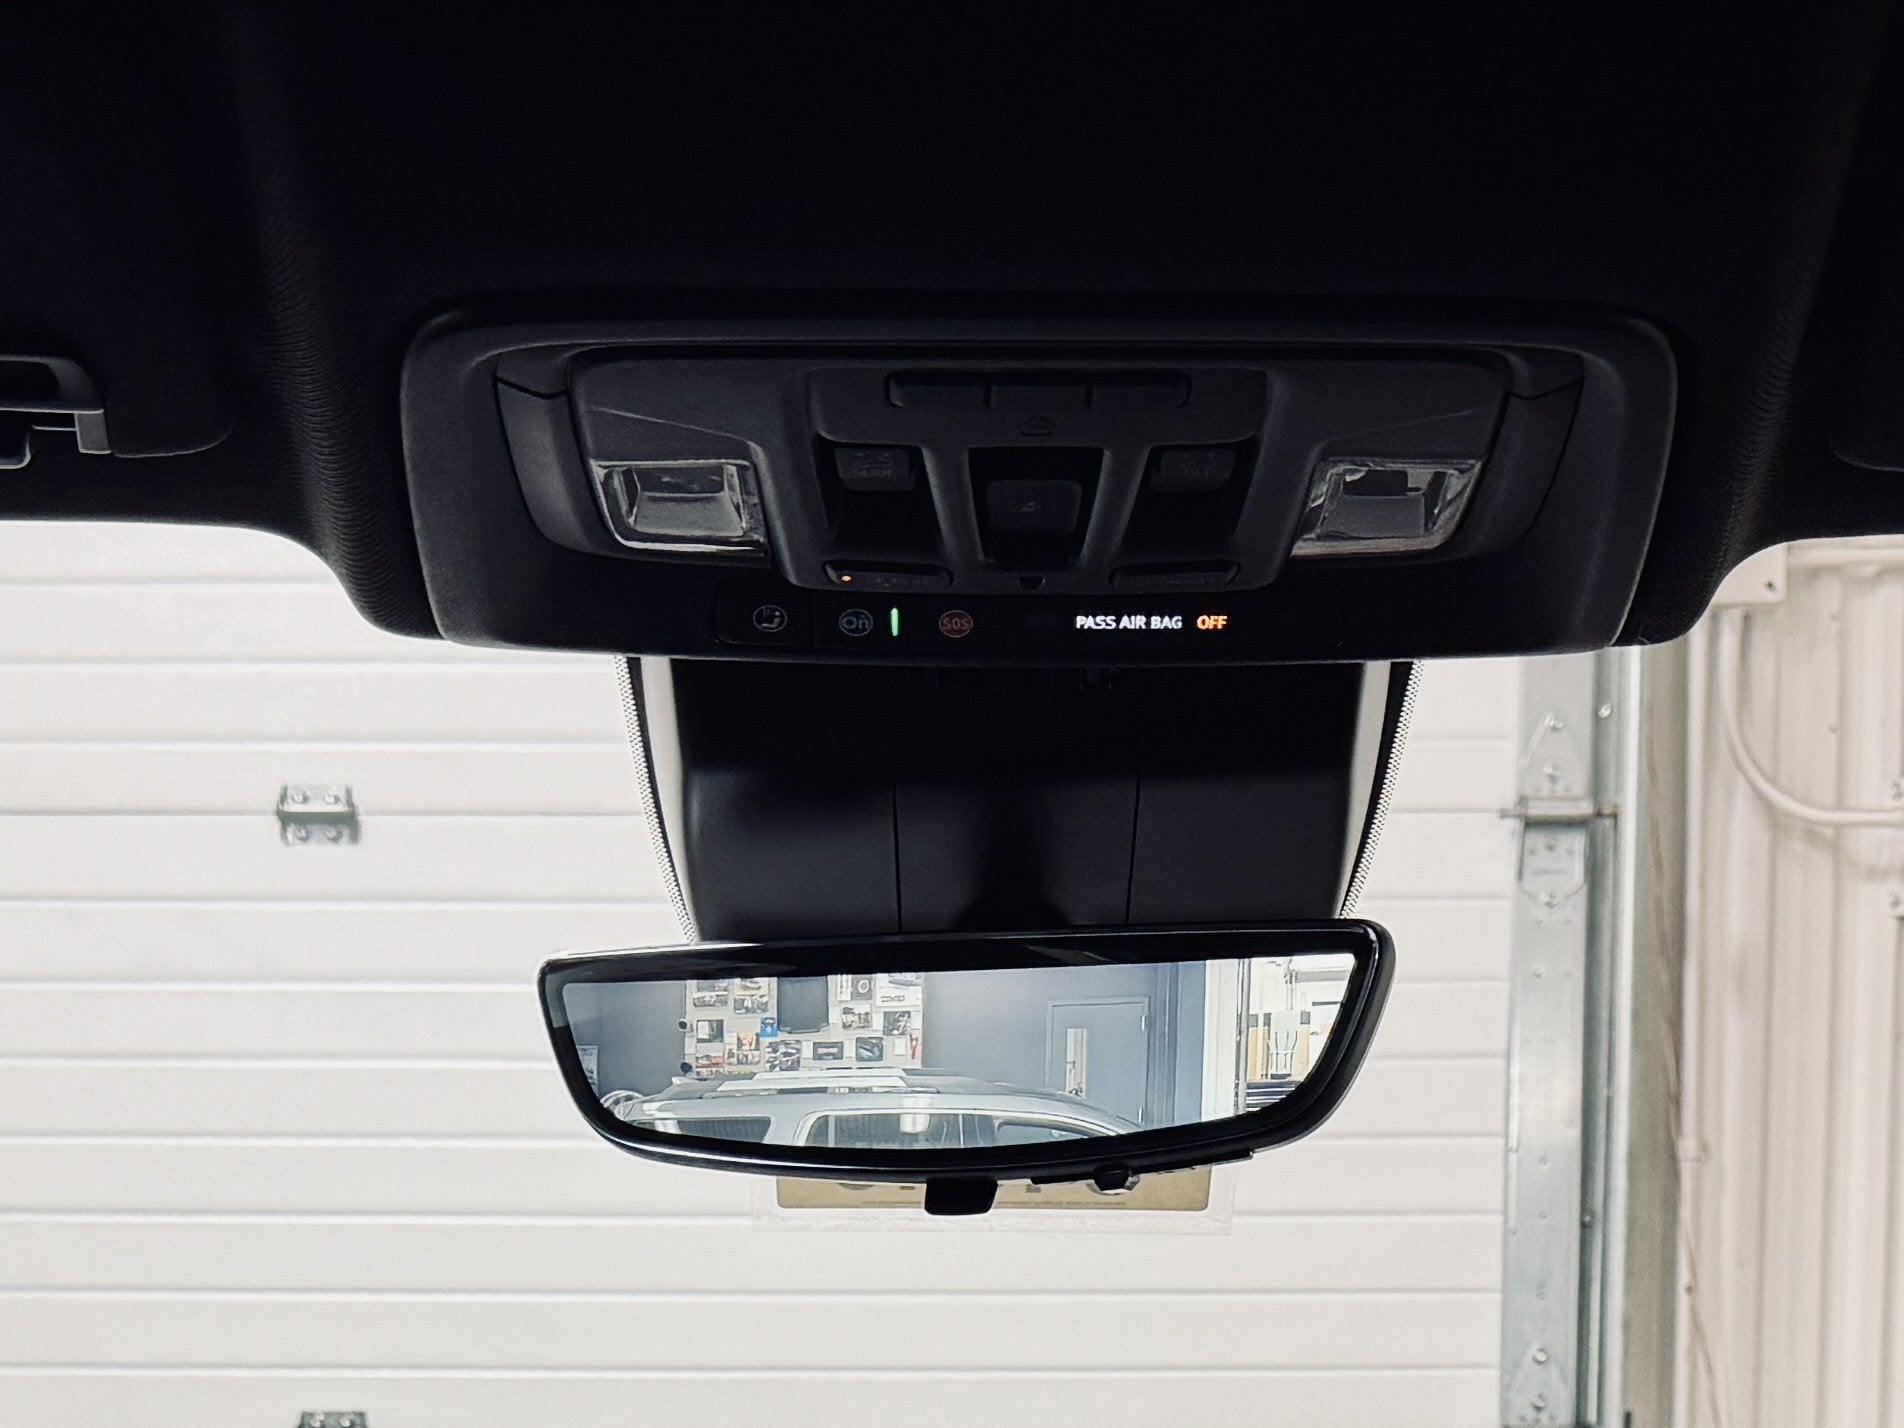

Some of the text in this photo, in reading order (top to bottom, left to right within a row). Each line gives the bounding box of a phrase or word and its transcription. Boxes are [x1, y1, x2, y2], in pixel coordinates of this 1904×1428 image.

[941, 617, 971, 631] SOS
[1075, 615, 1227, 630] PASS AIR BAG OFF
